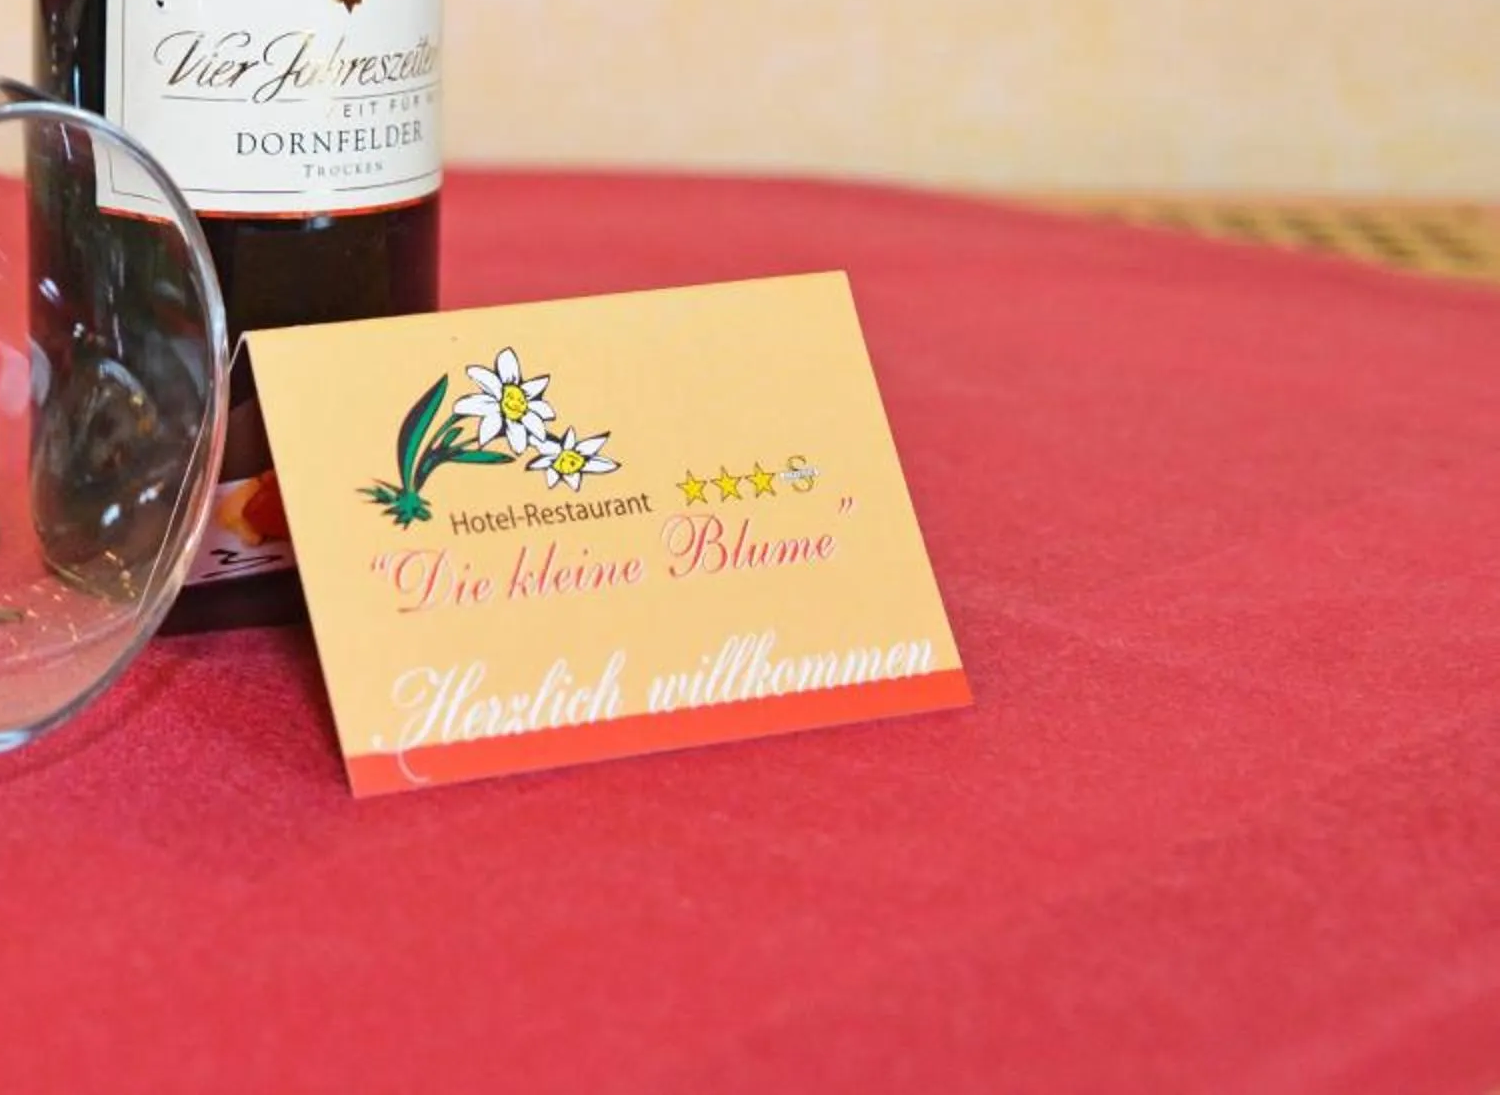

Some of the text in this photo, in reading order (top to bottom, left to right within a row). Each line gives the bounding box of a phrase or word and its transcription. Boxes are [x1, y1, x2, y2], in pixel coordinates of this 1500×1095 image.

[154, 30, 260, 88] Vier
[236, 119, 424, 156] DORNFELDER
[449, 492, 654, 536] Hotel-Restaurant
[507, 540, 644, 599] kleine
[371, 629, 934, 784] Herzlich willkommen
